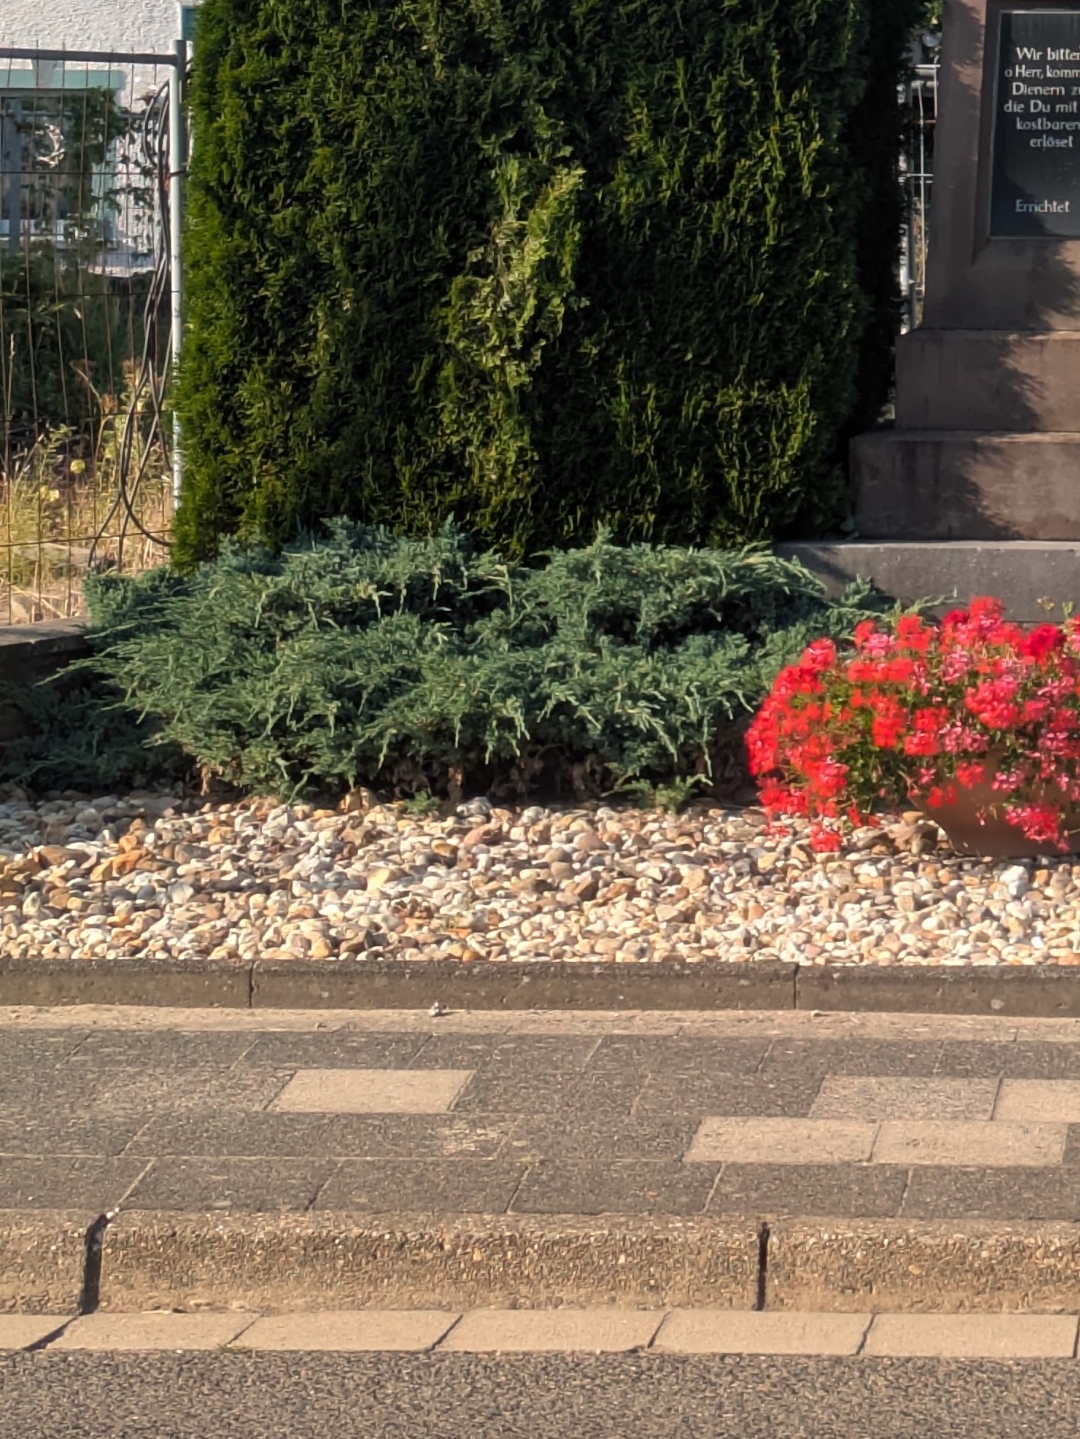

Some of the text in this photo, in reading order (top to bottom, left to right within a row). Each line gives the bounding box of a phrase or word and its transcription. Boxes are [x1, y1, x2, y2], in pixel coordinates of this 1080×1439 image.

[1016, 47, 1042, 60] Wir
[1005, 69, 1013, 78] o
[1012, 82, 1065, 95] Dienern
[1004, 100, 1024, 113] die
[1030, 100, 1050, 113] Du
[1055, 100, 1077, 113] mit
[1016, 117, 1080, 130] kostbaren
[1015, 199, 1069, 212] Errichtet
